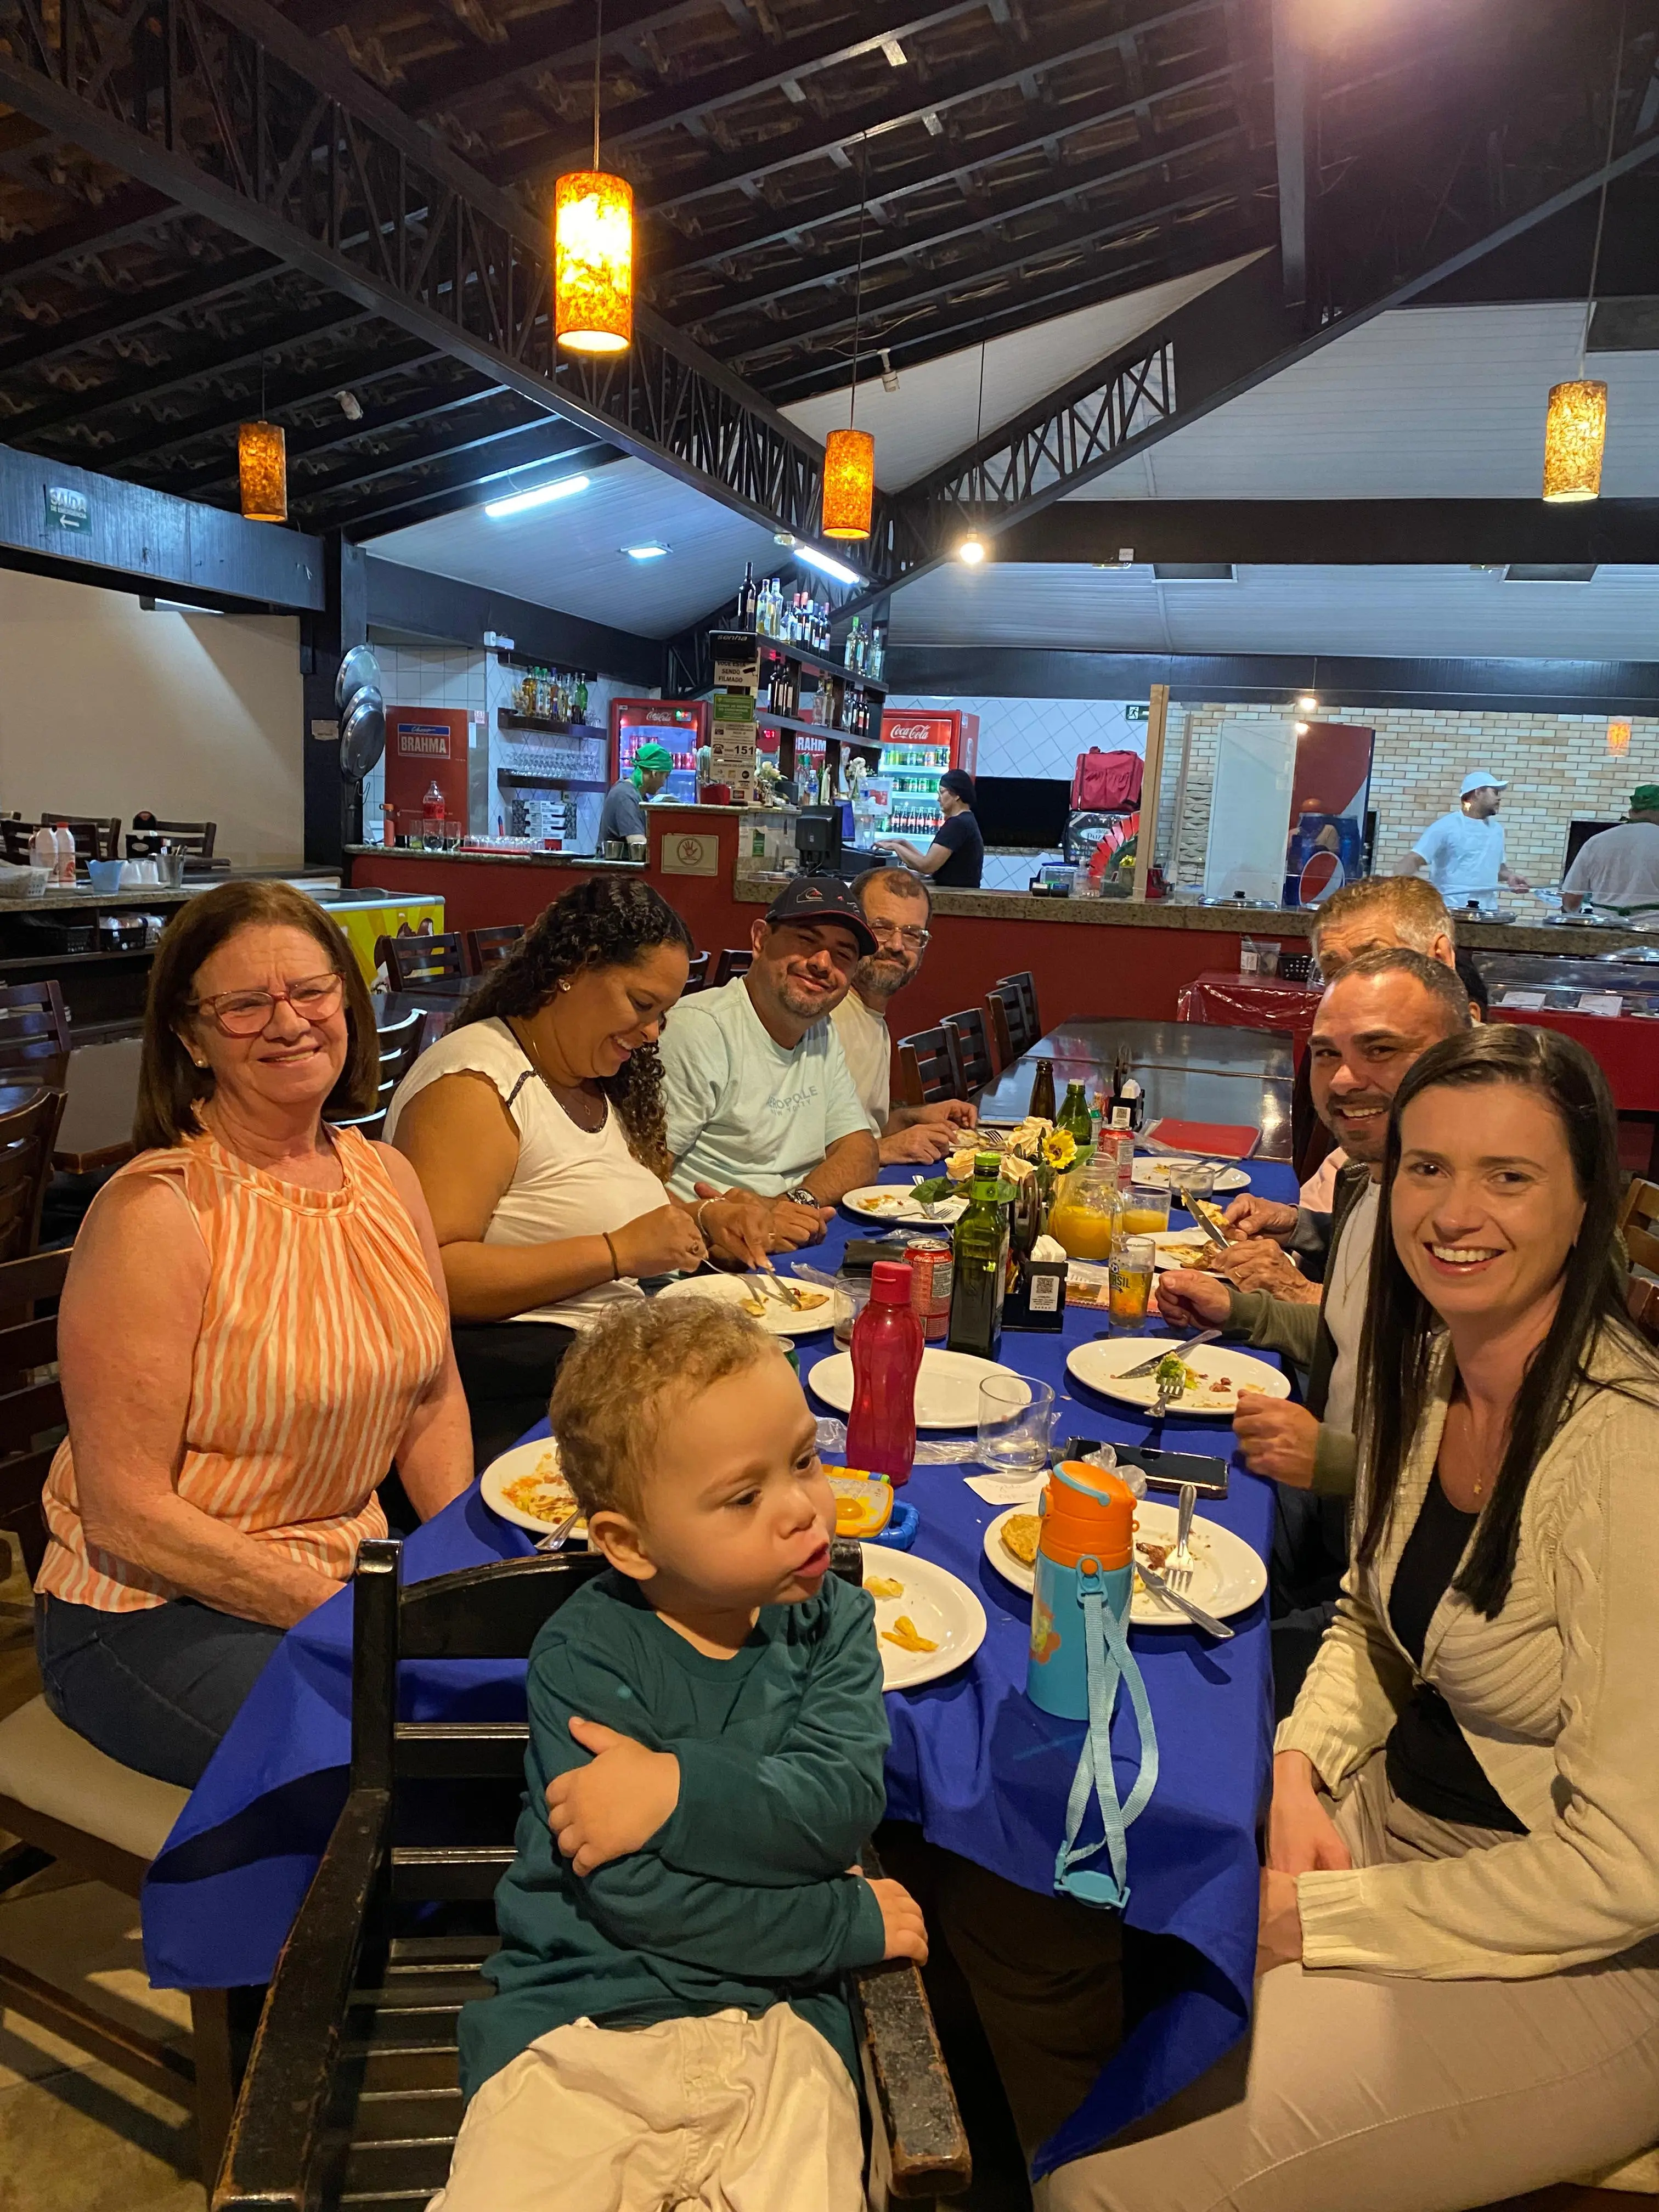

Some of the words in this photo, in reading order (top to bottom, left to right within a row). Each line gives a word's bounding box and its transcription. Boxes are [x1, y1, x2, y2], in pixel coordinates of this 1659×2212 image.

[401, 736, 447, 753] BRAHMA
[735, 745, 753, 755] 151
[795, 737, 826, 751] RAHM
